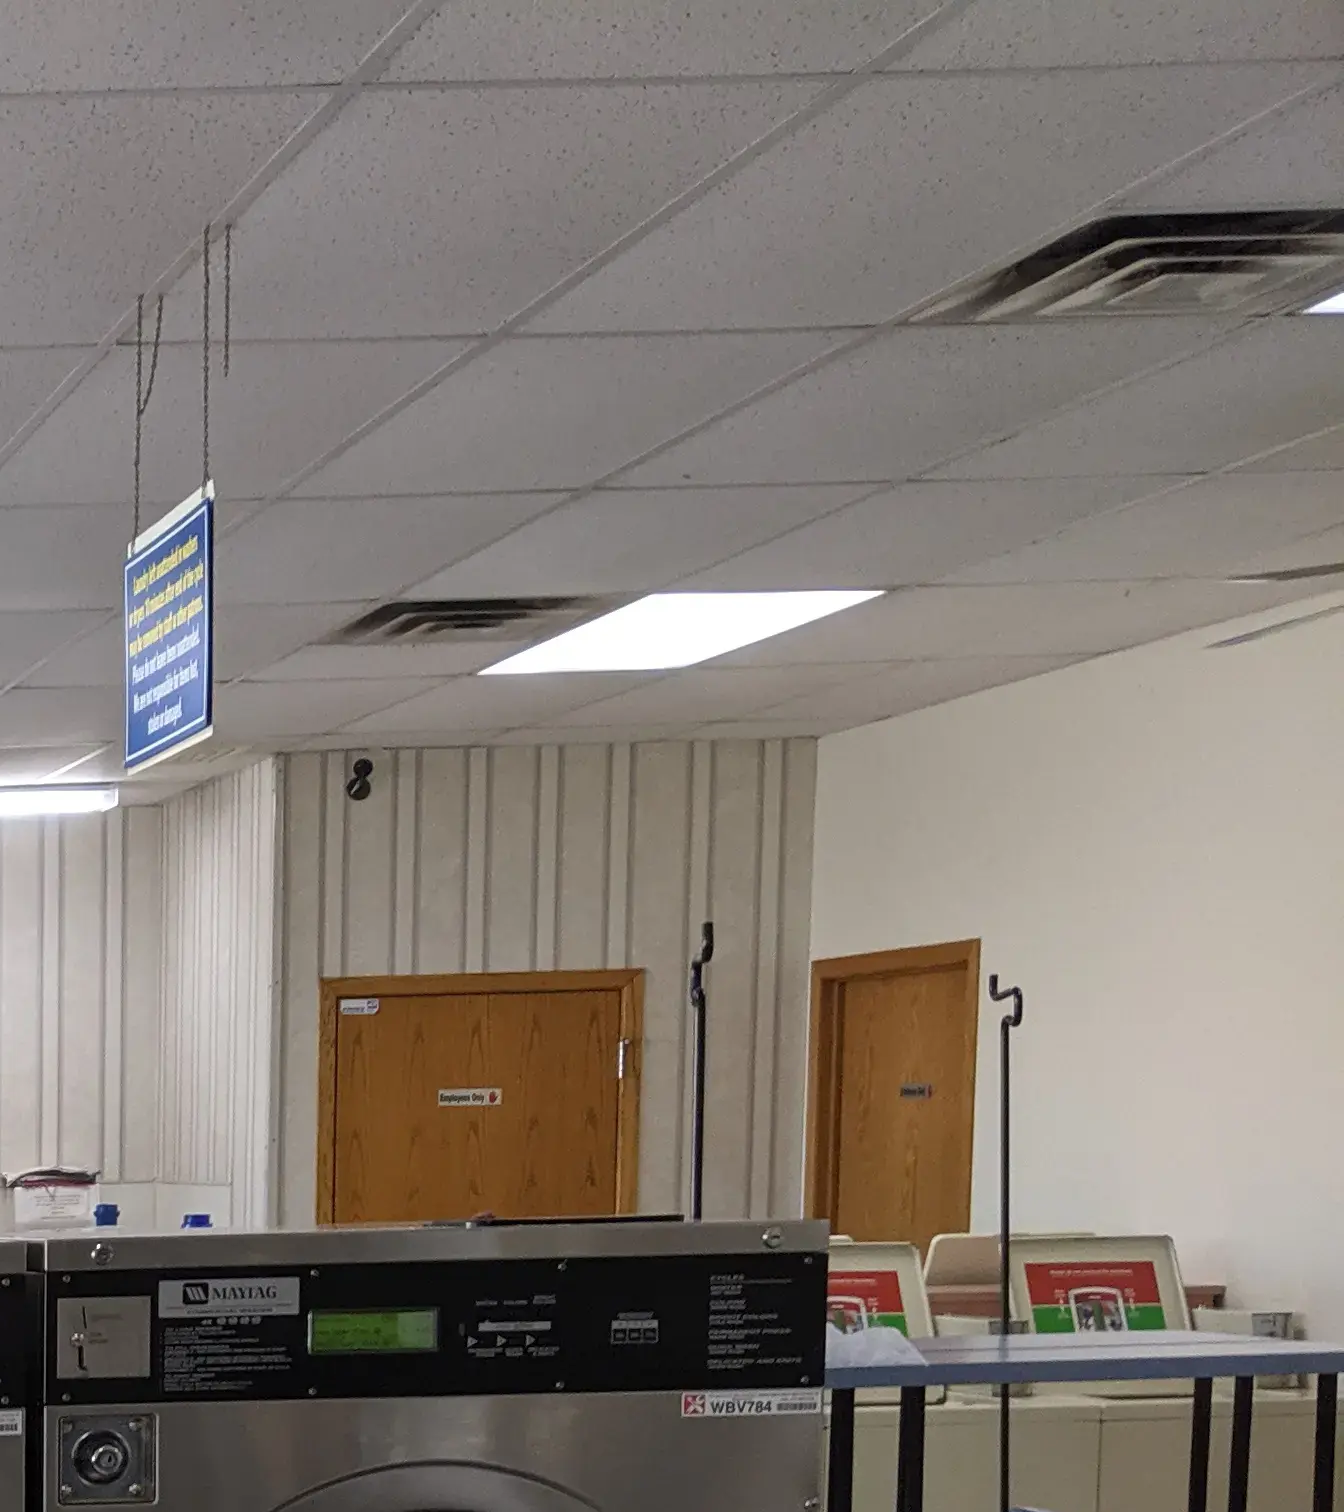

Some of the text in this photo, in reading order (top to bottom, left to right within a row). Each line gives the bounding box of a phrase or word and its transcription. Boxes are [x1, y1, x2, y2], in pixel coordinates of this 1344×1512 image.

[440, 1093, 484, 1103] Employees Only
[212, 1286, 277, 1300] MAYTAG
[711, 1401, 772, 1413] WBV784
